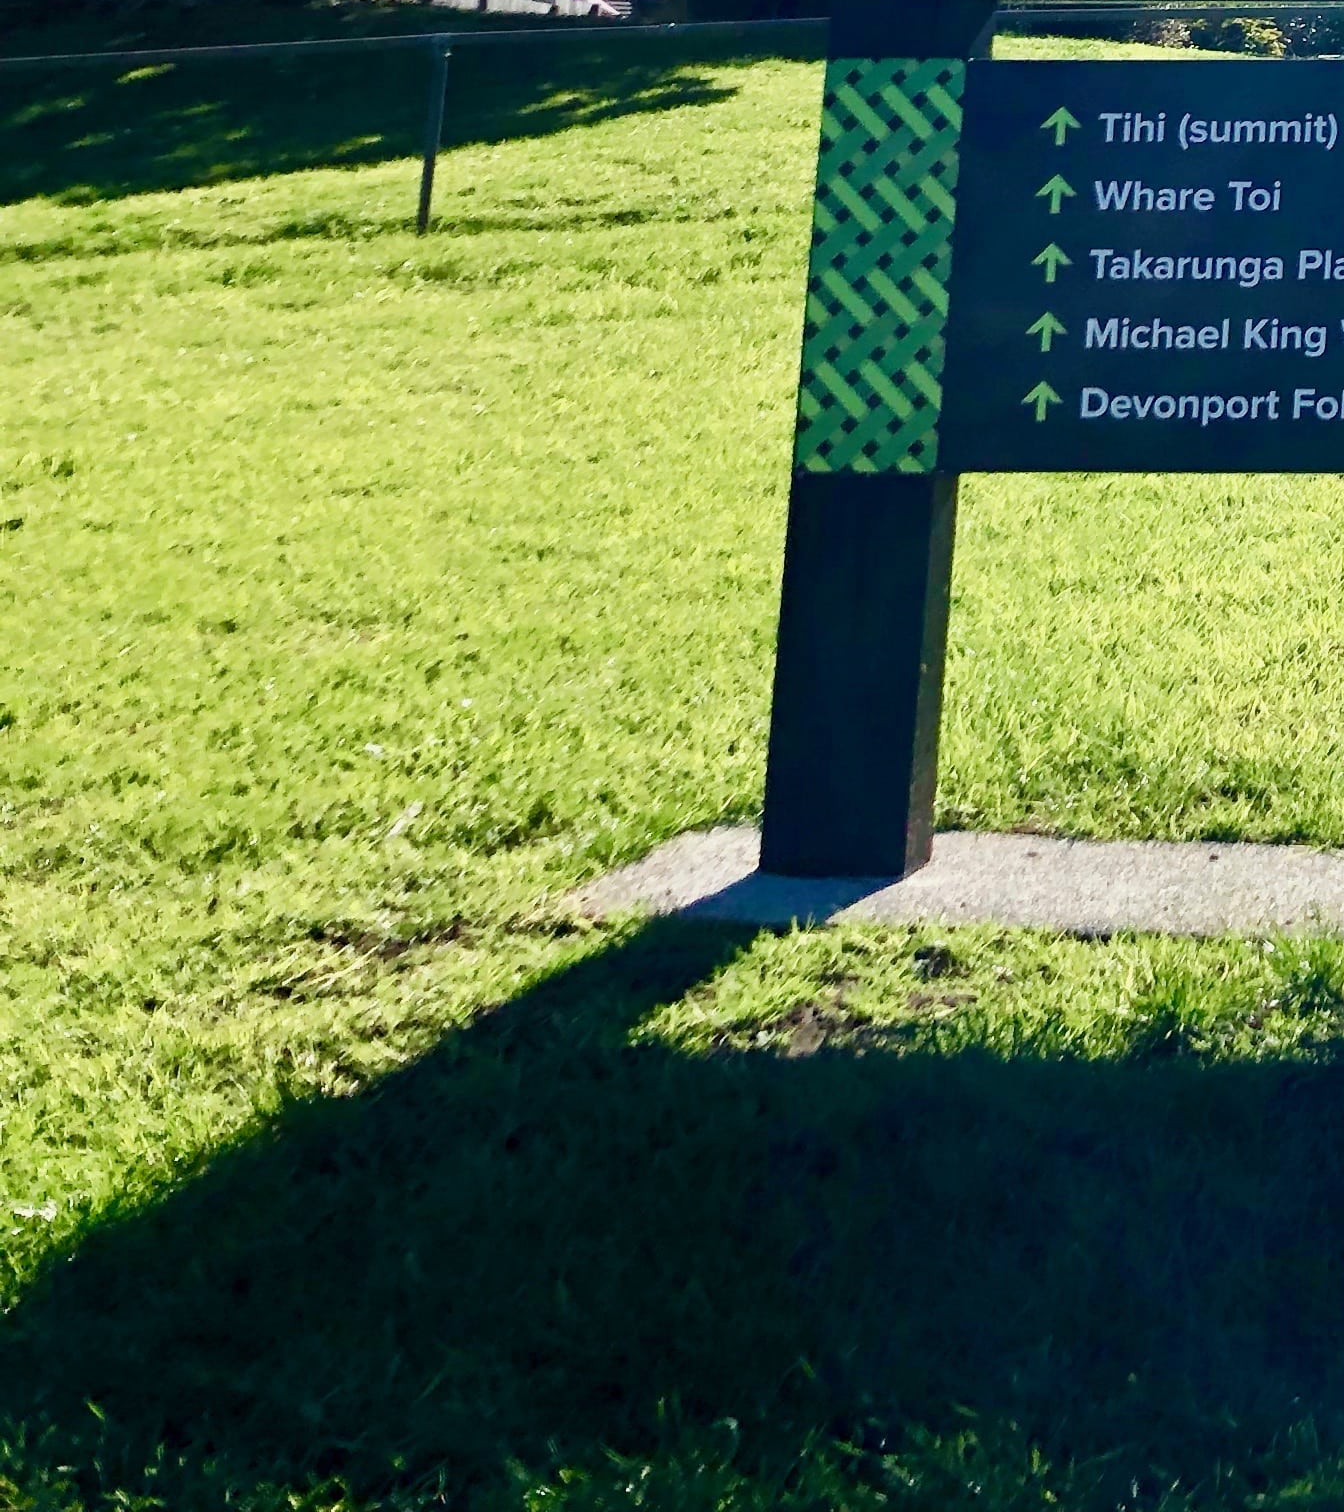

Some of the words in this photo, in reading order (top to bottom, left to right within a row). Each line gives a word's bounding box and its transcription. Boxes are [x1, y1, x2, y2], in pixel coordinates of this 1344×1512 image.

[1099, 113, 1165, 142] Tihi
[1179, 113, 1337, 150] (summit)
[1095, 181, 1215, 210] Whare
[1229, 181, 1280, 210] Toi
[1090, 249, 1283, 287] Takarunga
[1086, 318, 1229, 349] Michael
[1244, 319, 1326, 357] King
[1081, 388, 1279, 426] Devonport
